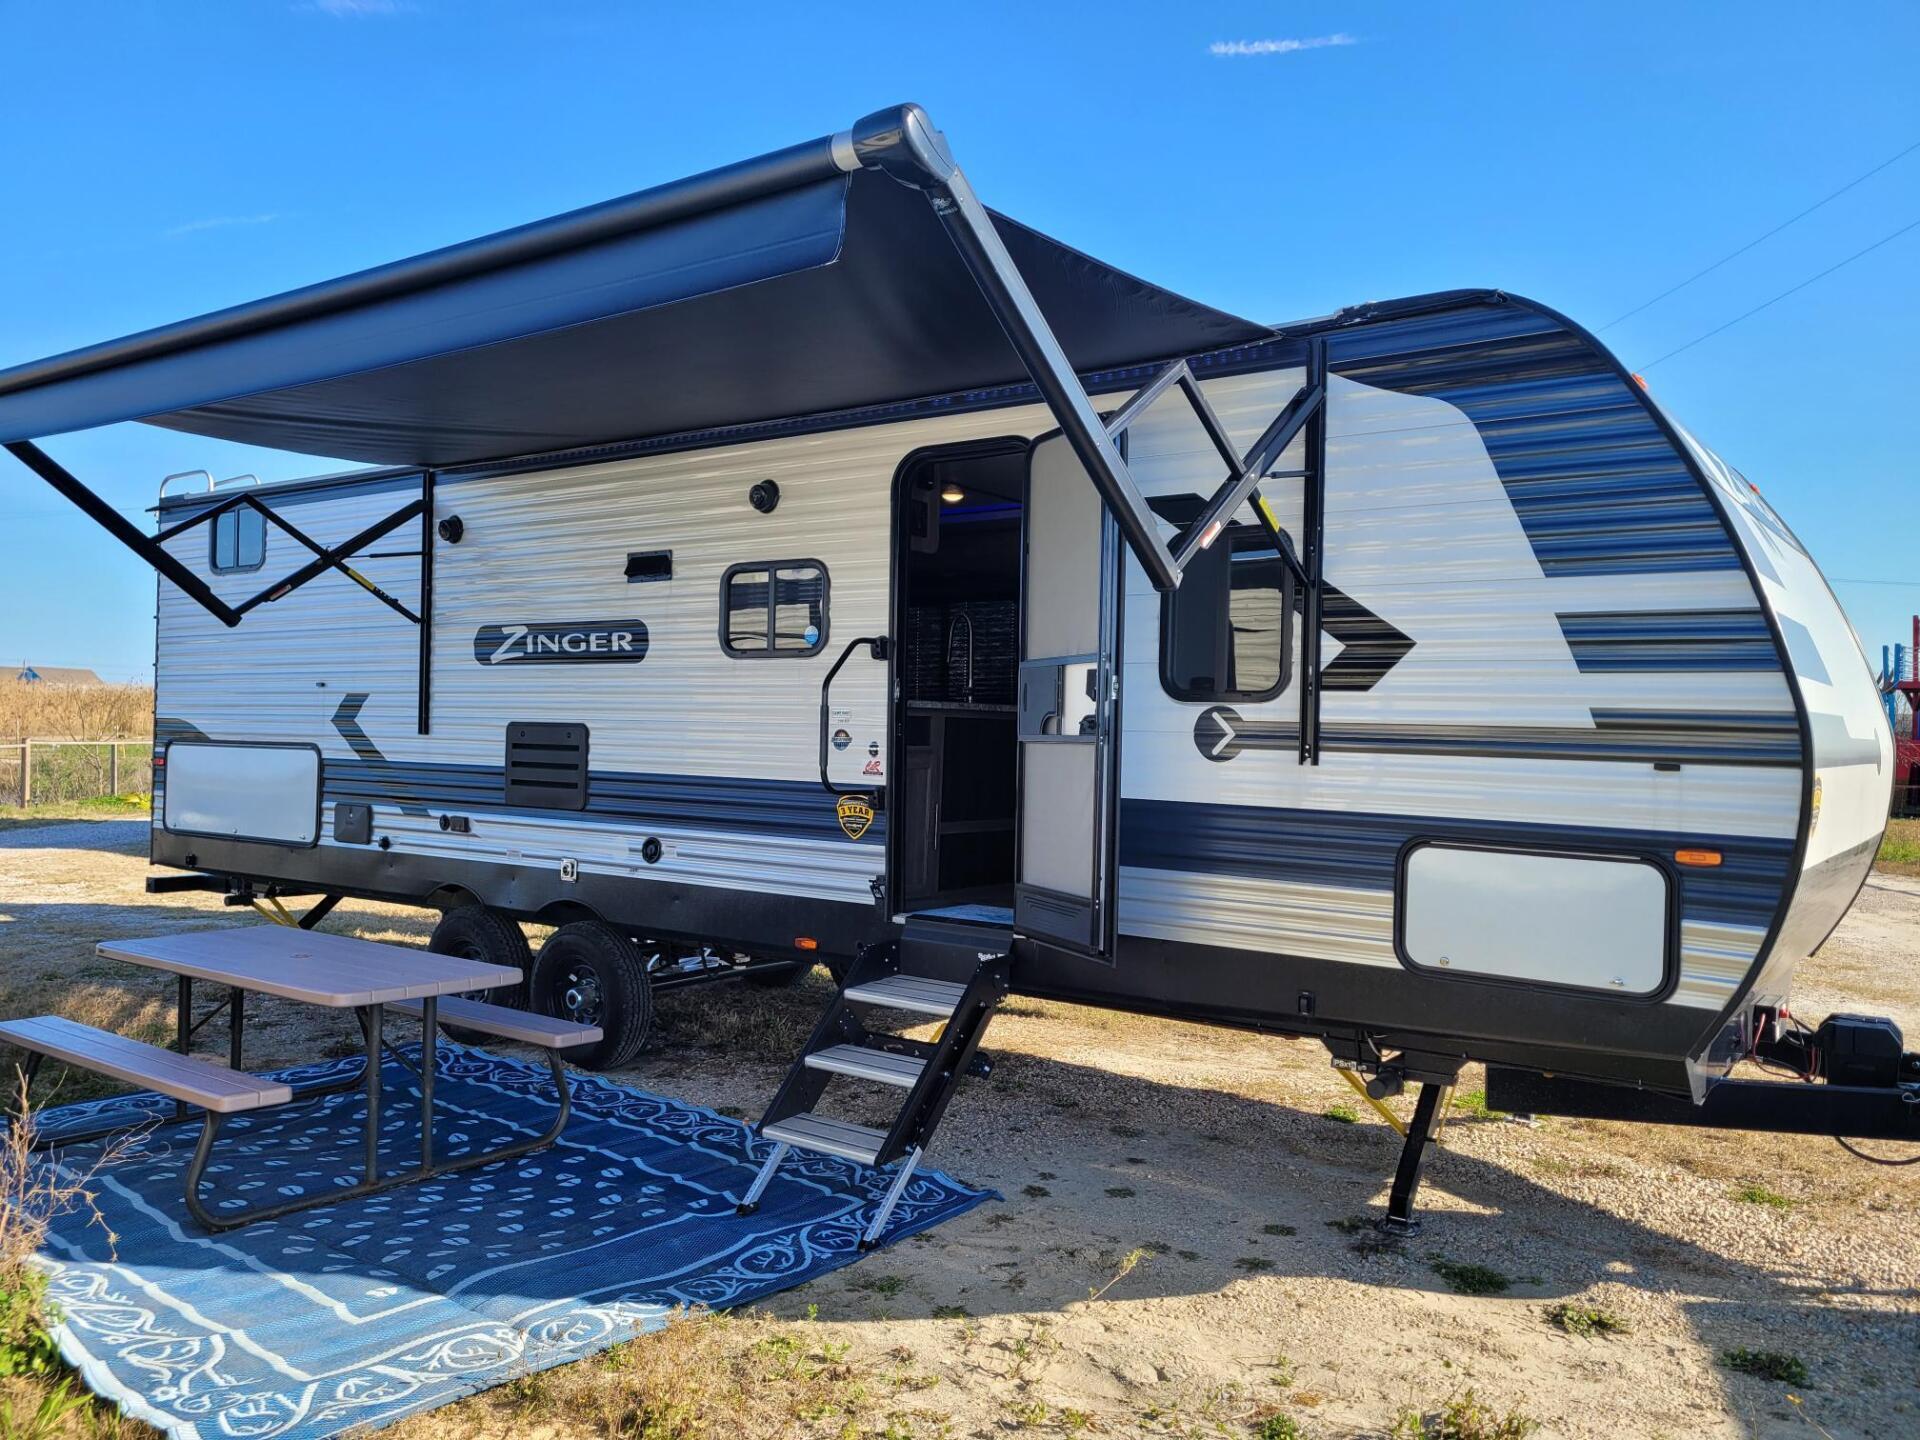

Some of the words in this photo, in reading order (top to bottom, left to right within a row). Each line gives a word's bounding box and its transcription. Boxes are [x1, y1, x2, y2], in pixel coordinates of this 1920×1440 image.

[489, 625, 633, 664] ZINGER
[840, 807, 847, 815] 3
[847, 806, 870, 817] YEAR
